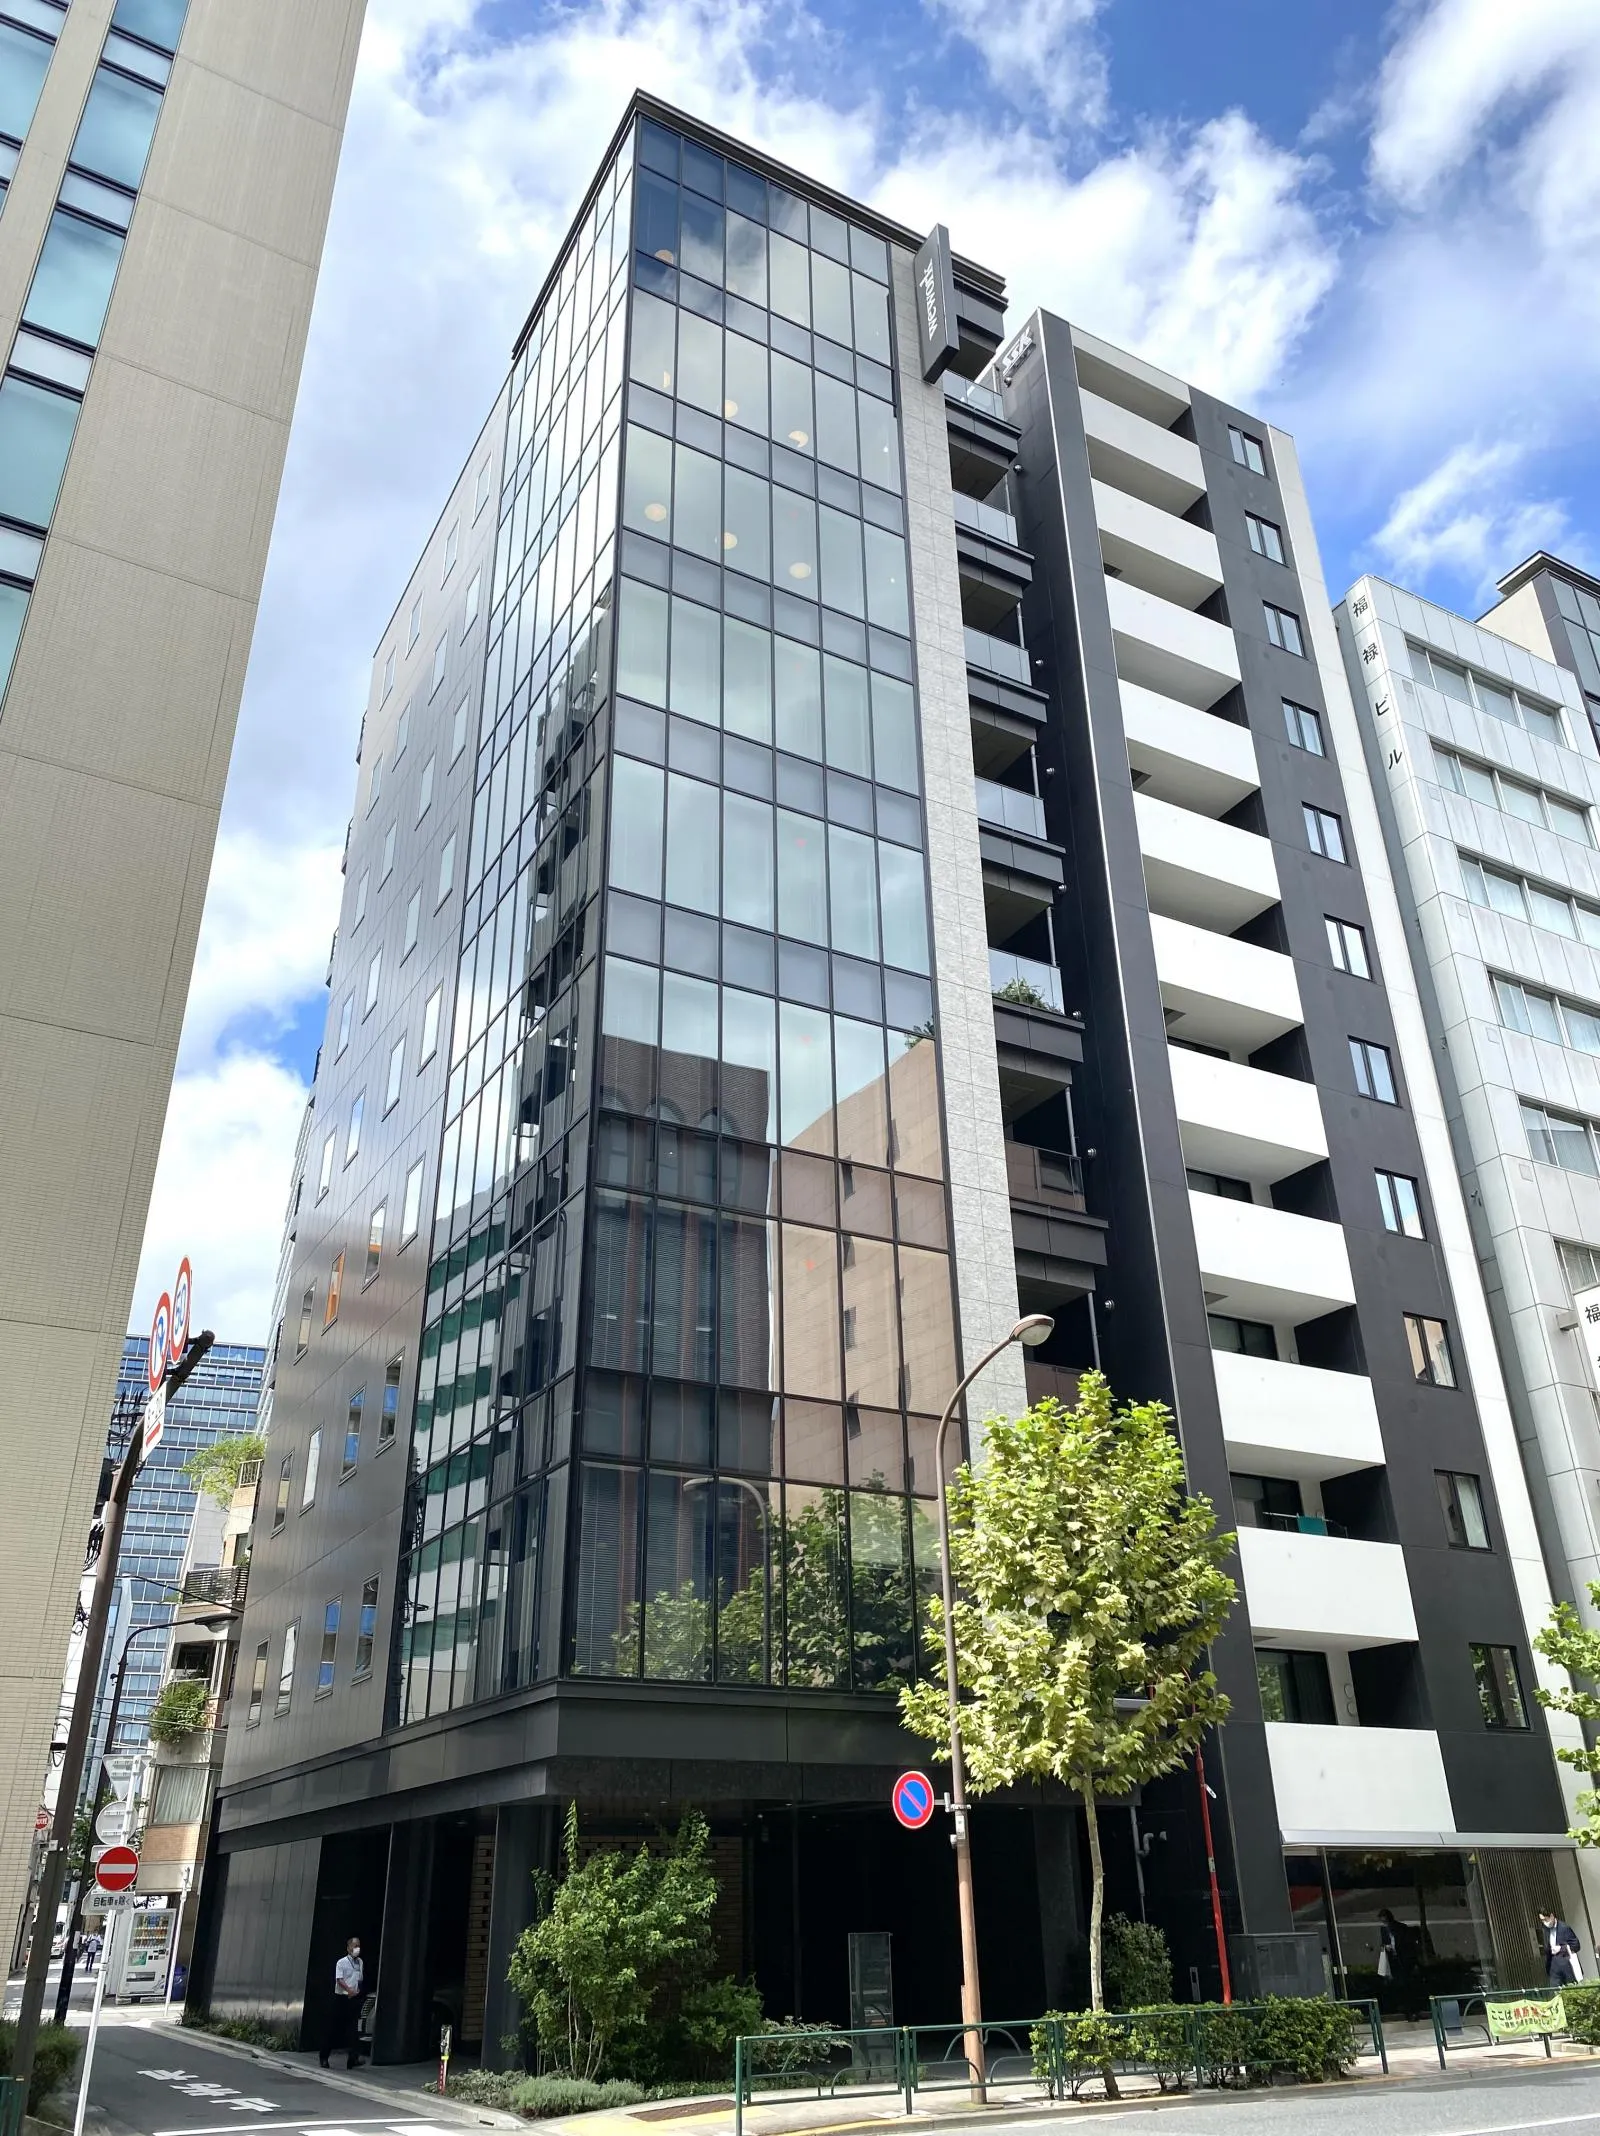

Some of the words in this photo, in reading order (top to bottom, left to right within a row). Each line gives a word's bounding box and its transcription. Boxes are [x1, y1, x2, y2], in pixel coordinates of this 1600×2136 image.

[1352, 594, 1403, 770] 福禄ビル
[93, 1896, 131, 1907] 自転車を除く
[136, 2069, 281, 2112] 止まれ
